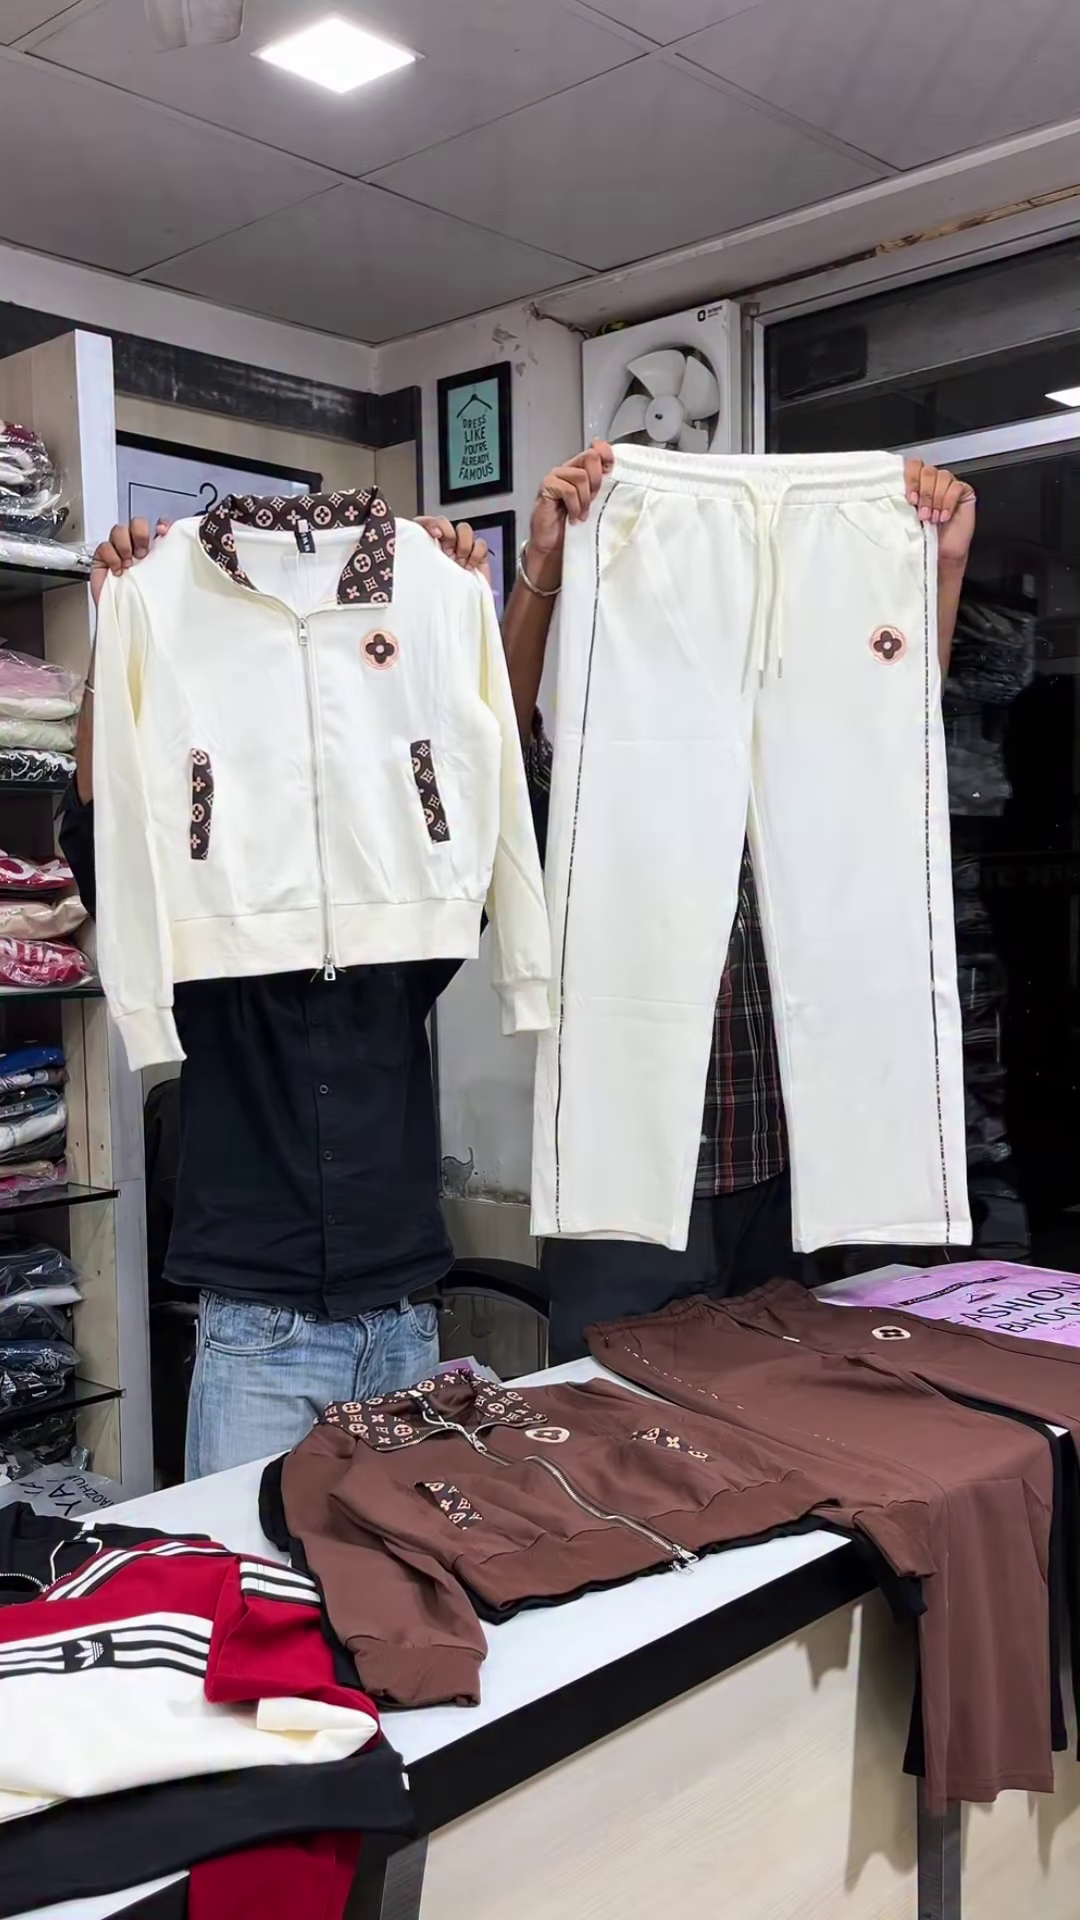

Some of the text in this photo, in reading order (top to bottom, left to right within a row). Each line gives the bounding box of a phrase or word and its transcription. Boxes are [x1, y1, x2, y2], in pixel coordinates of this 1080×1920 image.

[462, 414, 487, 429] DRESS
[464, 426, 486, 443] LIKE
[461, 452, 490, 467] ALREADY
[458, 462, 494, 481] FAMOUS
[943, 1281, 1080, 1325] ASHION
